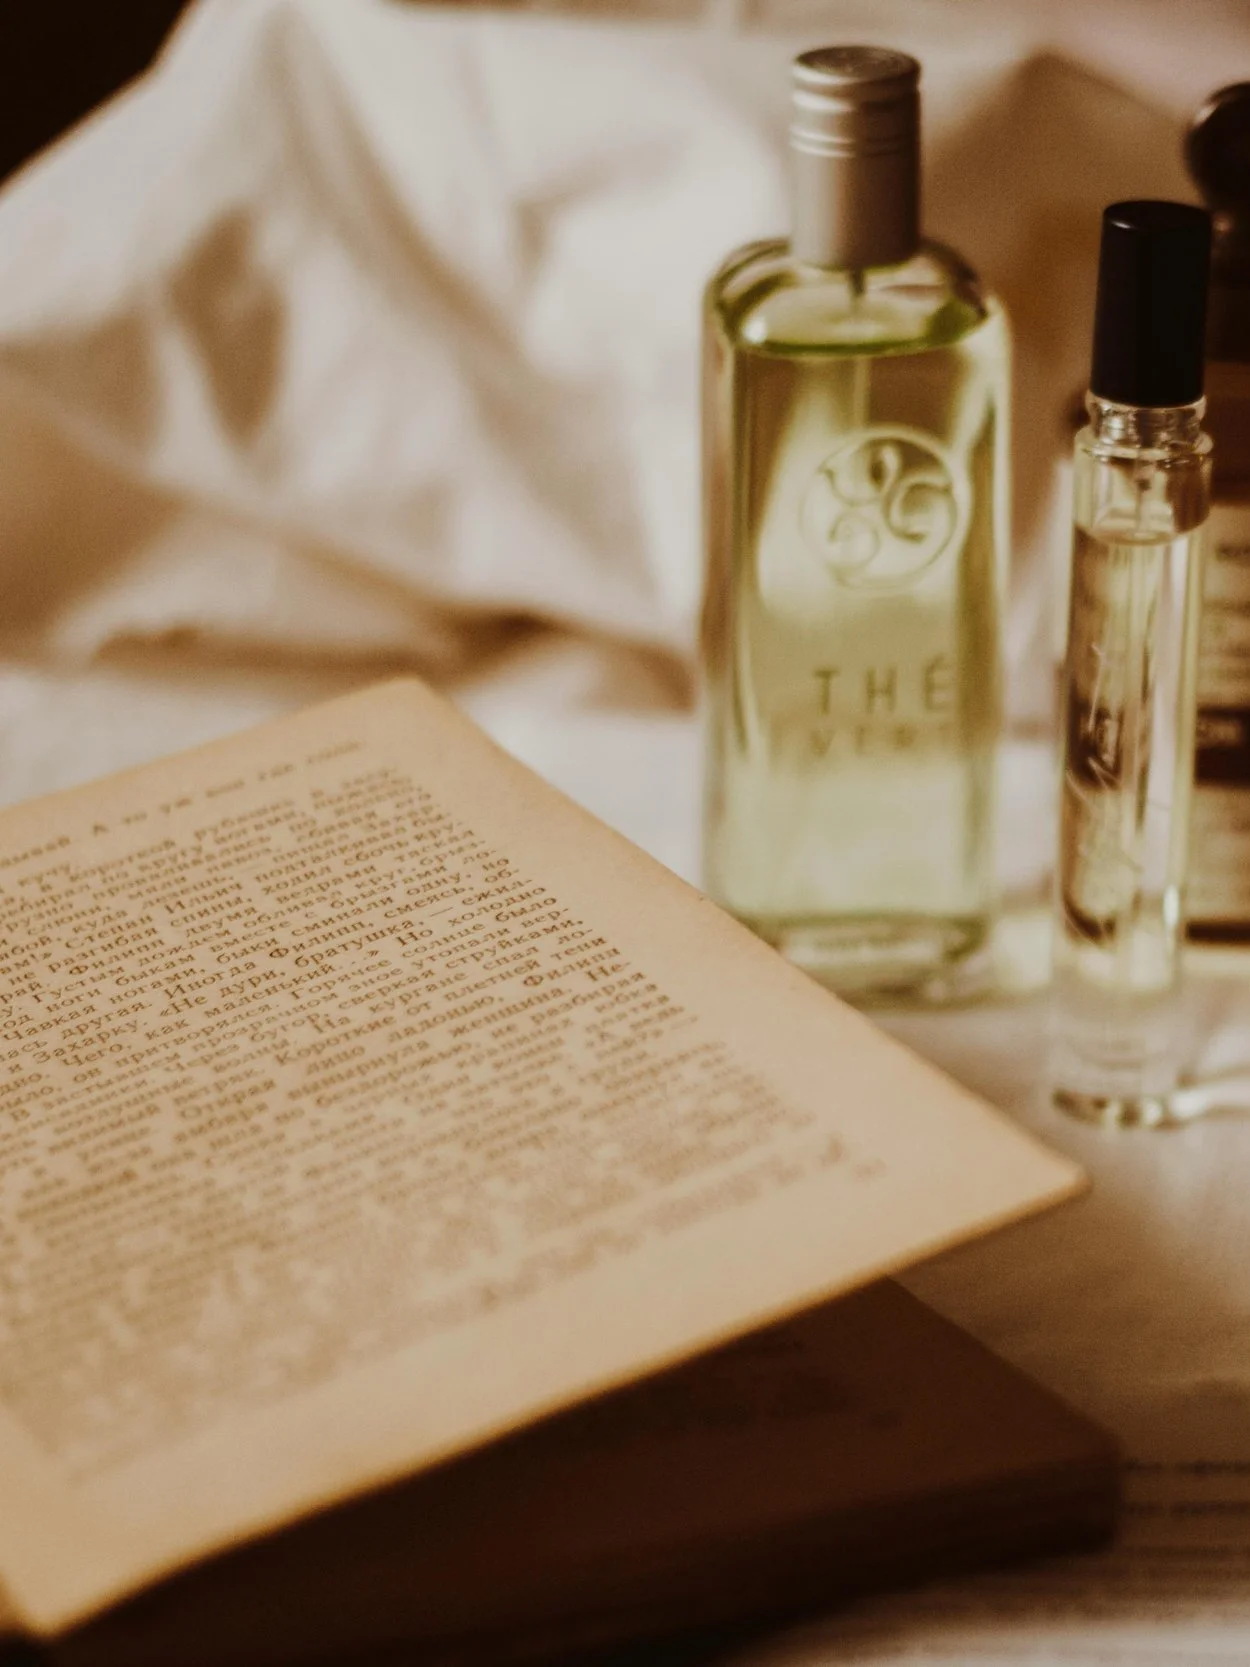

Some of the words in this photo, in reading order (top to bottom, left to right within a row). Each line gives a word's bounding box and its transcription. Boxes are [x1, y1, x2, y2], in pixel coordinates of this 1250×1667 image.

[812, 655, 951, 715] THÉ
[0, 883, 91, 921] ебирал
[3, 1004, 96, 1041] Чавкая
[109, 967, 206, 1005] ногами,
[216, 937, 279, 964] быки
[291, 896, 394, 937] сминали
[406, 871, 472, 896] одну,
[481, 858, 510, 872] но
[9, 971, 35, 986] не
[47, 927, 158, 974] разгибая
[170, 896, 253, 927] спины,
[261, 865, 332, 896] ходил
[343, 840, 409, 866] сбочь
[413, 821, 463, 842] кру-
[32, 966, 125, 1004] Густым
[138, 929, 231, 968] дождем
[242, 885, 341, 929] обливал
[45, 988, 101, 1013] ноги
[114, 953, 195, 986] быкам
[209, 920, 289, 953] вместе
[330, 865, 447, 909] брызгами
[463, 850, 497, 865] ло-
[61, 1001, 153, 1041] другая.
[163, 961, 256, 1000] Иногда
[269, 920, 374, 959] Филипп,
[383, 886, 474, 919] смеясь,
[484, 868, 520, 884] об-
[64, 915, 153, 949] Степан
[164, 882, 242, 915] Ильич
[254, 826, 406, 884] подталкивал
[68, 939, 165, 976] Филипп
[185, 906, 258, 938] двумя
[276, 864, 377, 905] ведрами
[395, 829, 475, 863] таскал
[72, 910, 128, 935] куда
[32, 1019, 148, 1065] Захарку.
[159, 996, 207, 1017] «Не
[219, 969, 286, 999] дури,
[294, 920, 424, 968] братушка,
[461, 879, 533, 906] ежил-
[63, 1040, 132, 1067] Чего,
[144, 1019, 190, 1041] как
[395, 929, 433, 947] Но
[447, 887, 547, 927] холодно
[72, 1067, 102, 1084] он
[115, 1003, 273, 1068] притворялся.
[290, 959, 389, 1001] Горячее
[401, 923, 486, 959] солнце
[494, 897, 557, 922] было
[164, 1043, 240, 1072] Через
[250, 1012, 332, 1043] бугор,
[338, 969, 436, 1010] сверкая
[445, 916, 584, 969] струйками,
[192, 992, 339, 1053] прозрачном
[348, 968, 403, 991] зное
[411, 927, 511, 970] утопали
[520, 908, 569, 929] вер-
[274, 1016, 394, 1067] Короткие
[406, 1001, 431, 1016] от
[443, 959, 541, 1002] плетней
[550, 936, 606, 961] тени
[311, 1016, 351, 1034] На
[369, 972, 466, 1014] кургане
[482, 946, 539, 971] спал
[558, 928, 593, 945] ло-
[388, 995, 504, 1043] ладонью,
[522, 947, 619, 987] Филипп
[449, 987, 572, 1038] женщина.
[585, 962, 630, 982] Не-
[530, 971, 650, 1026] разбирая
